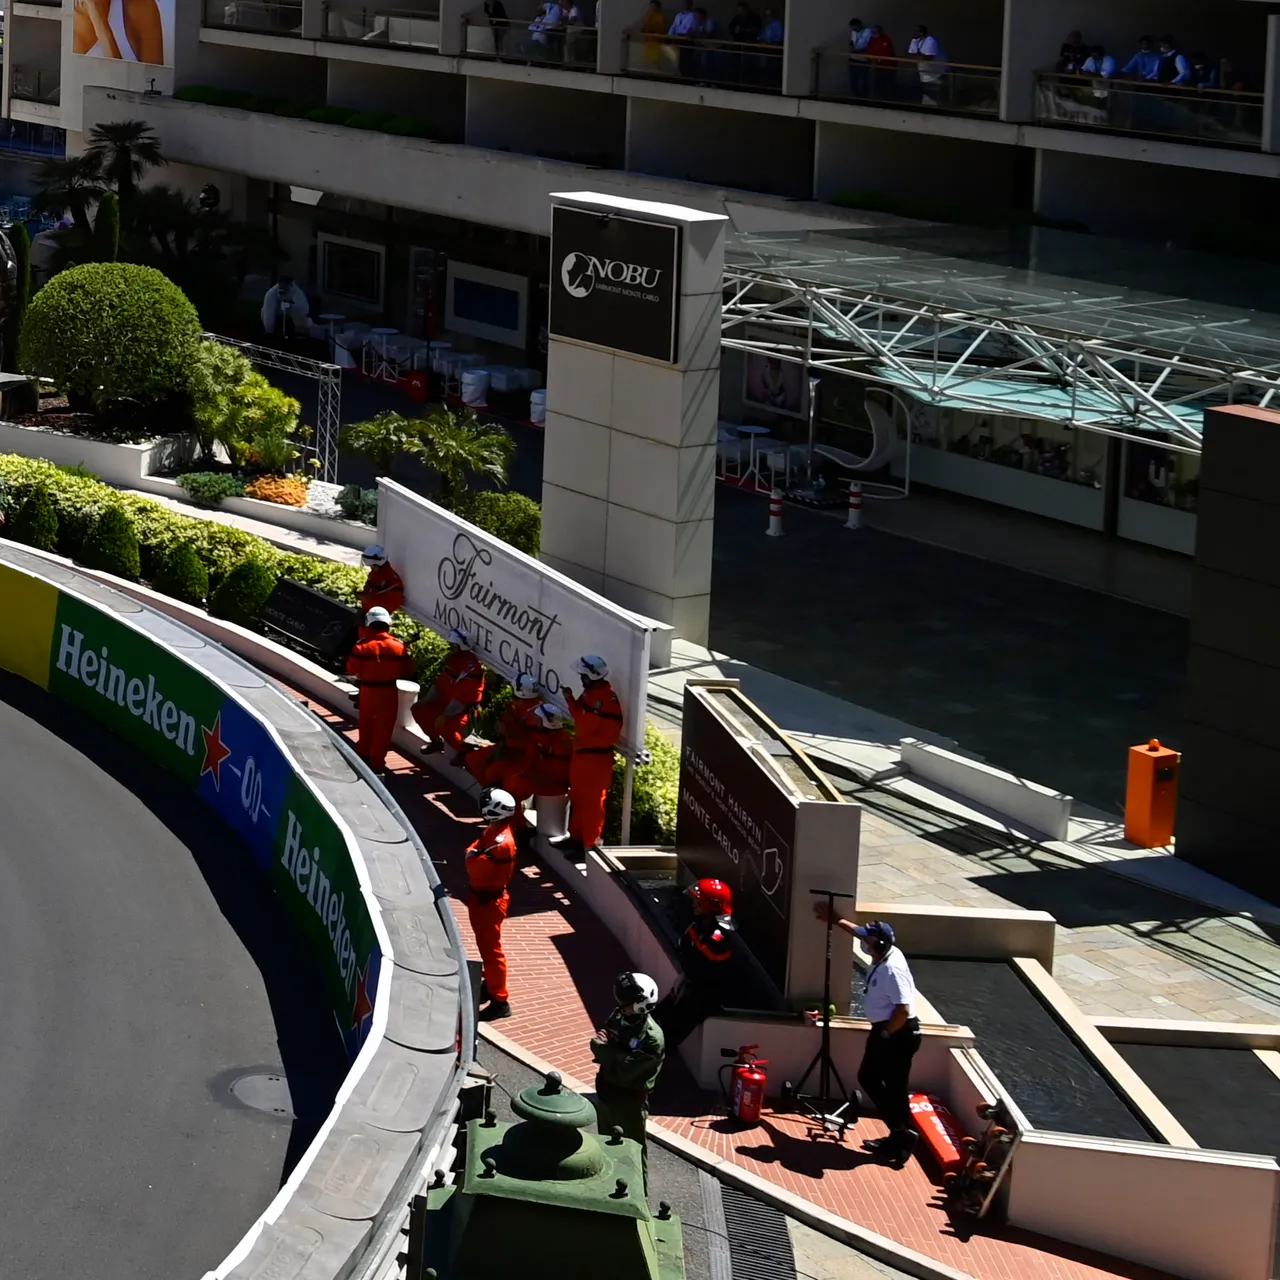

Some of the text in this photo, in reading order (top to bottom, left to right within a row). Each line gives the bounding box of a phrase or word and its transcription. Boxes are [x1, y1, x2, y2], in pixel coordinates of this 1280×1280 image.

[586, 255, 662, 289] NOBU
[622, 287, 641, 299] MONTE
[642, 292, 660, 303] CARLO
[434, 597, 493, 654] MONTE
[438, 532, 562, 656] Fairmont
[56, 623, 196, 756] Heineken
[241, 756, 262, 823] 0.0
[683, 788, 739, 865] MONTE CARLO
[685, 746, 762, 842] FAIRMONT HAIRPIN
[281, 809, 356, 994] Heineken
